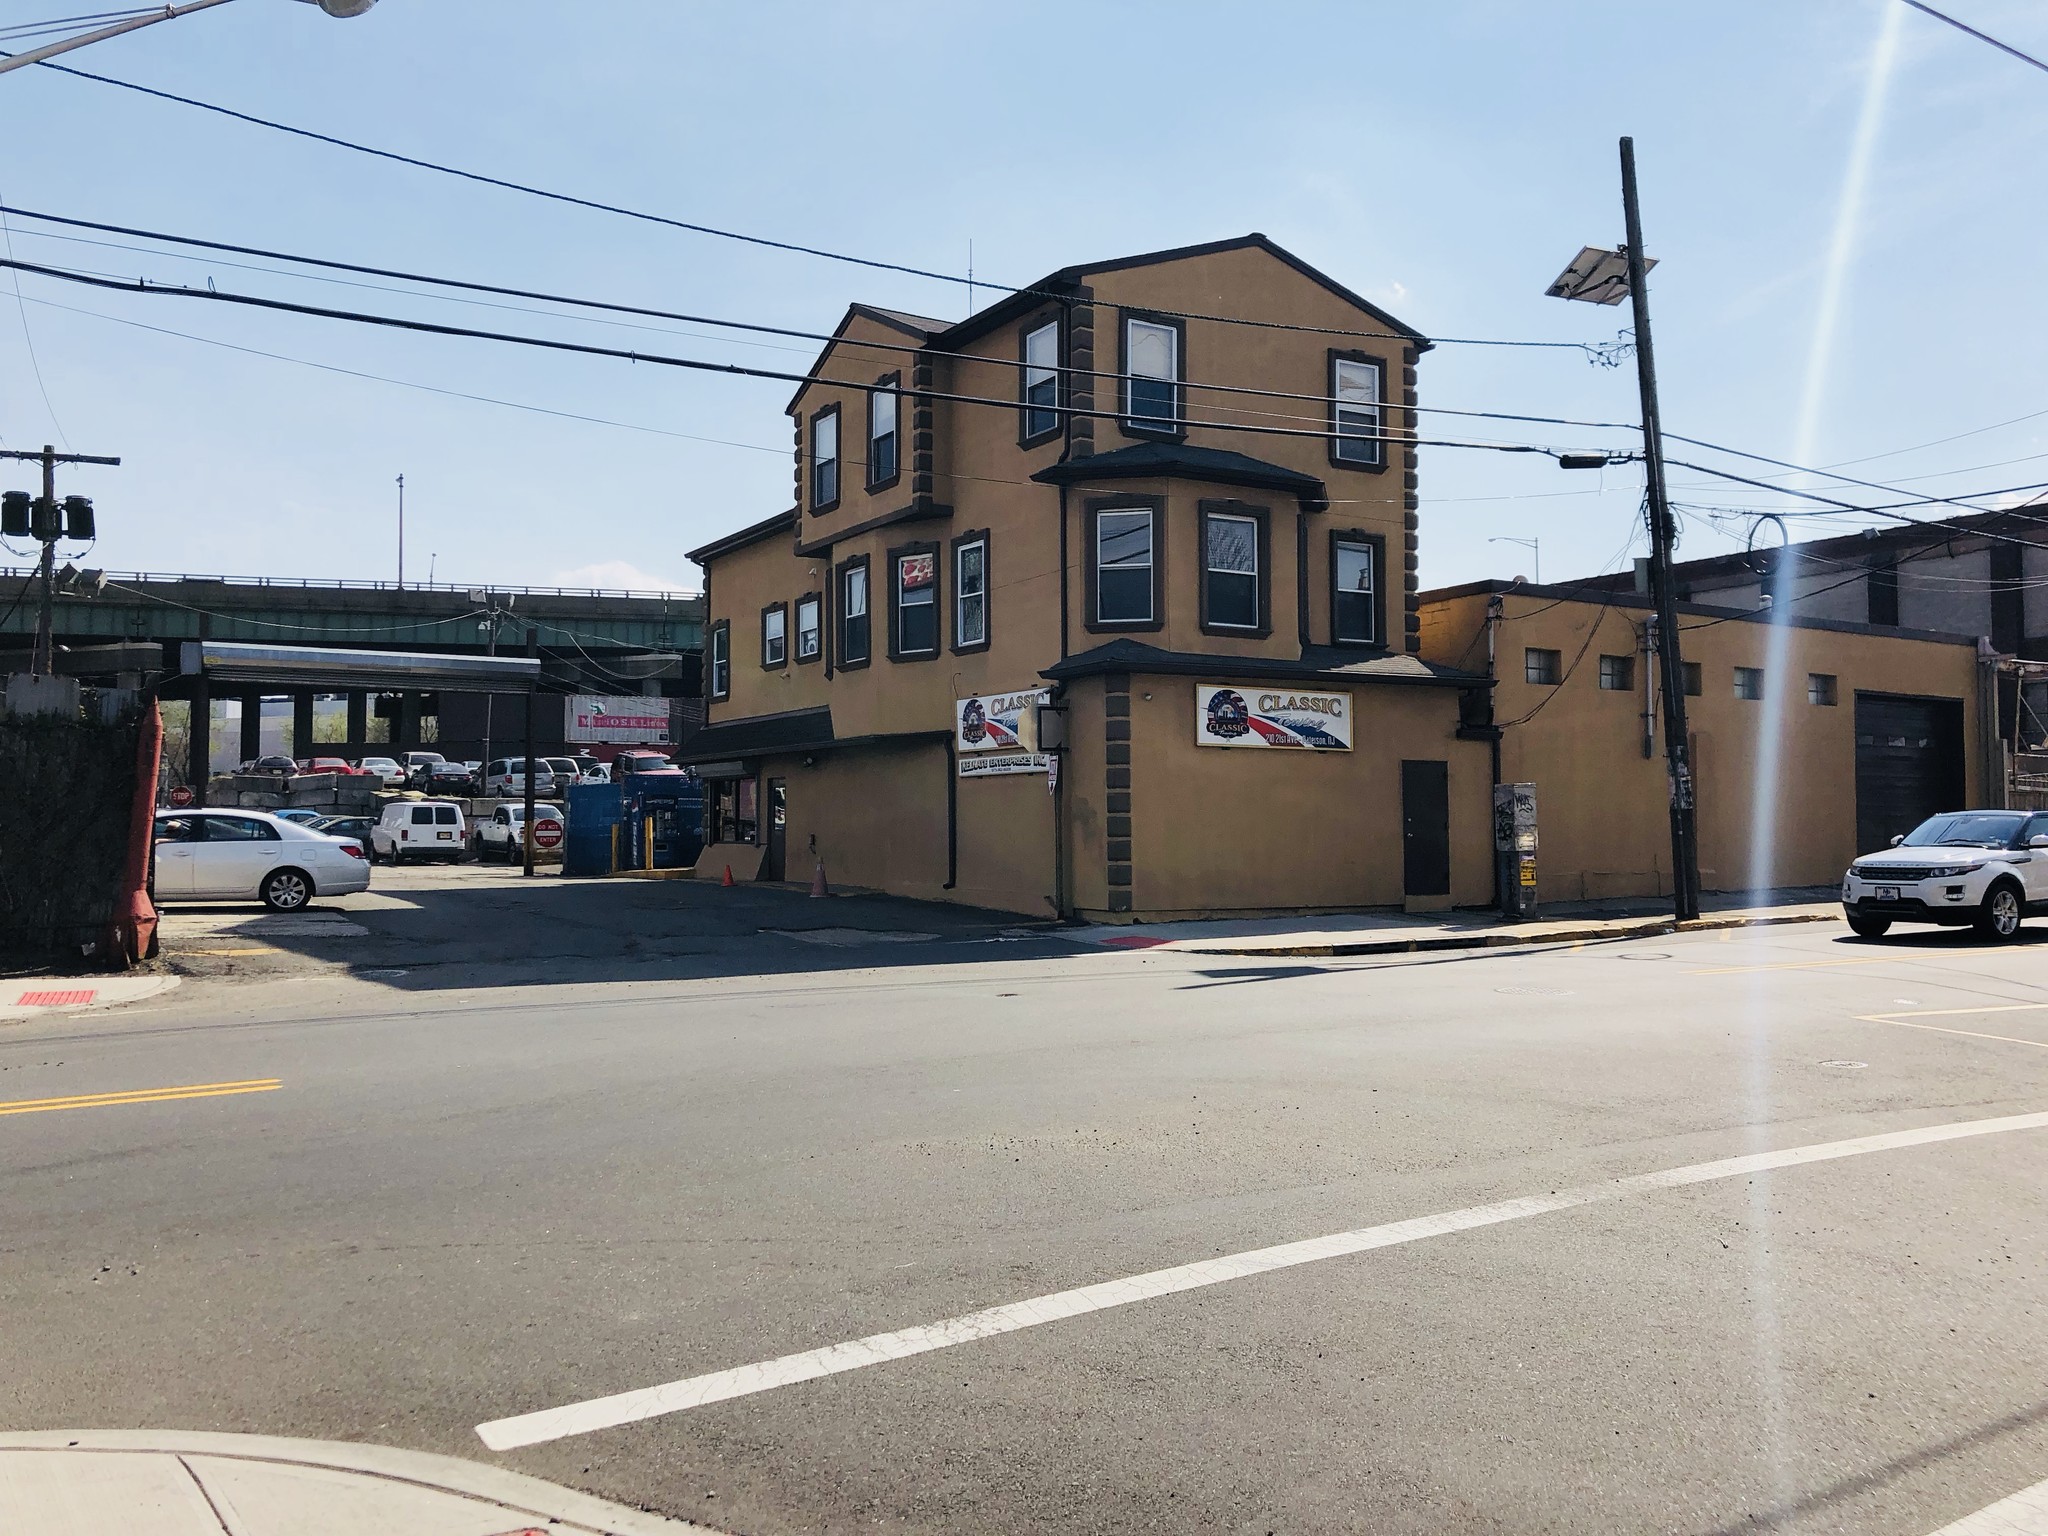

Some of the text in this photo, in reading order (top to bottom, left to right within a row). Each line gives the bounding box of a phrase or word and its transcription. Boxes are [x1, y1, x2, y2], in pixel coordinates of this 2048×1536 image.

[991, 692, 1044, 716] CLASSIC
[1258, 694, 1342, 717] CLASSIC
[1209, 723, 1248, 733] CLASSIC
[1275, 713, 1327, 732] Towing
[989, 755, 1032, 768] ENTERPRISES
[173, 792, 190, 800] STOP
